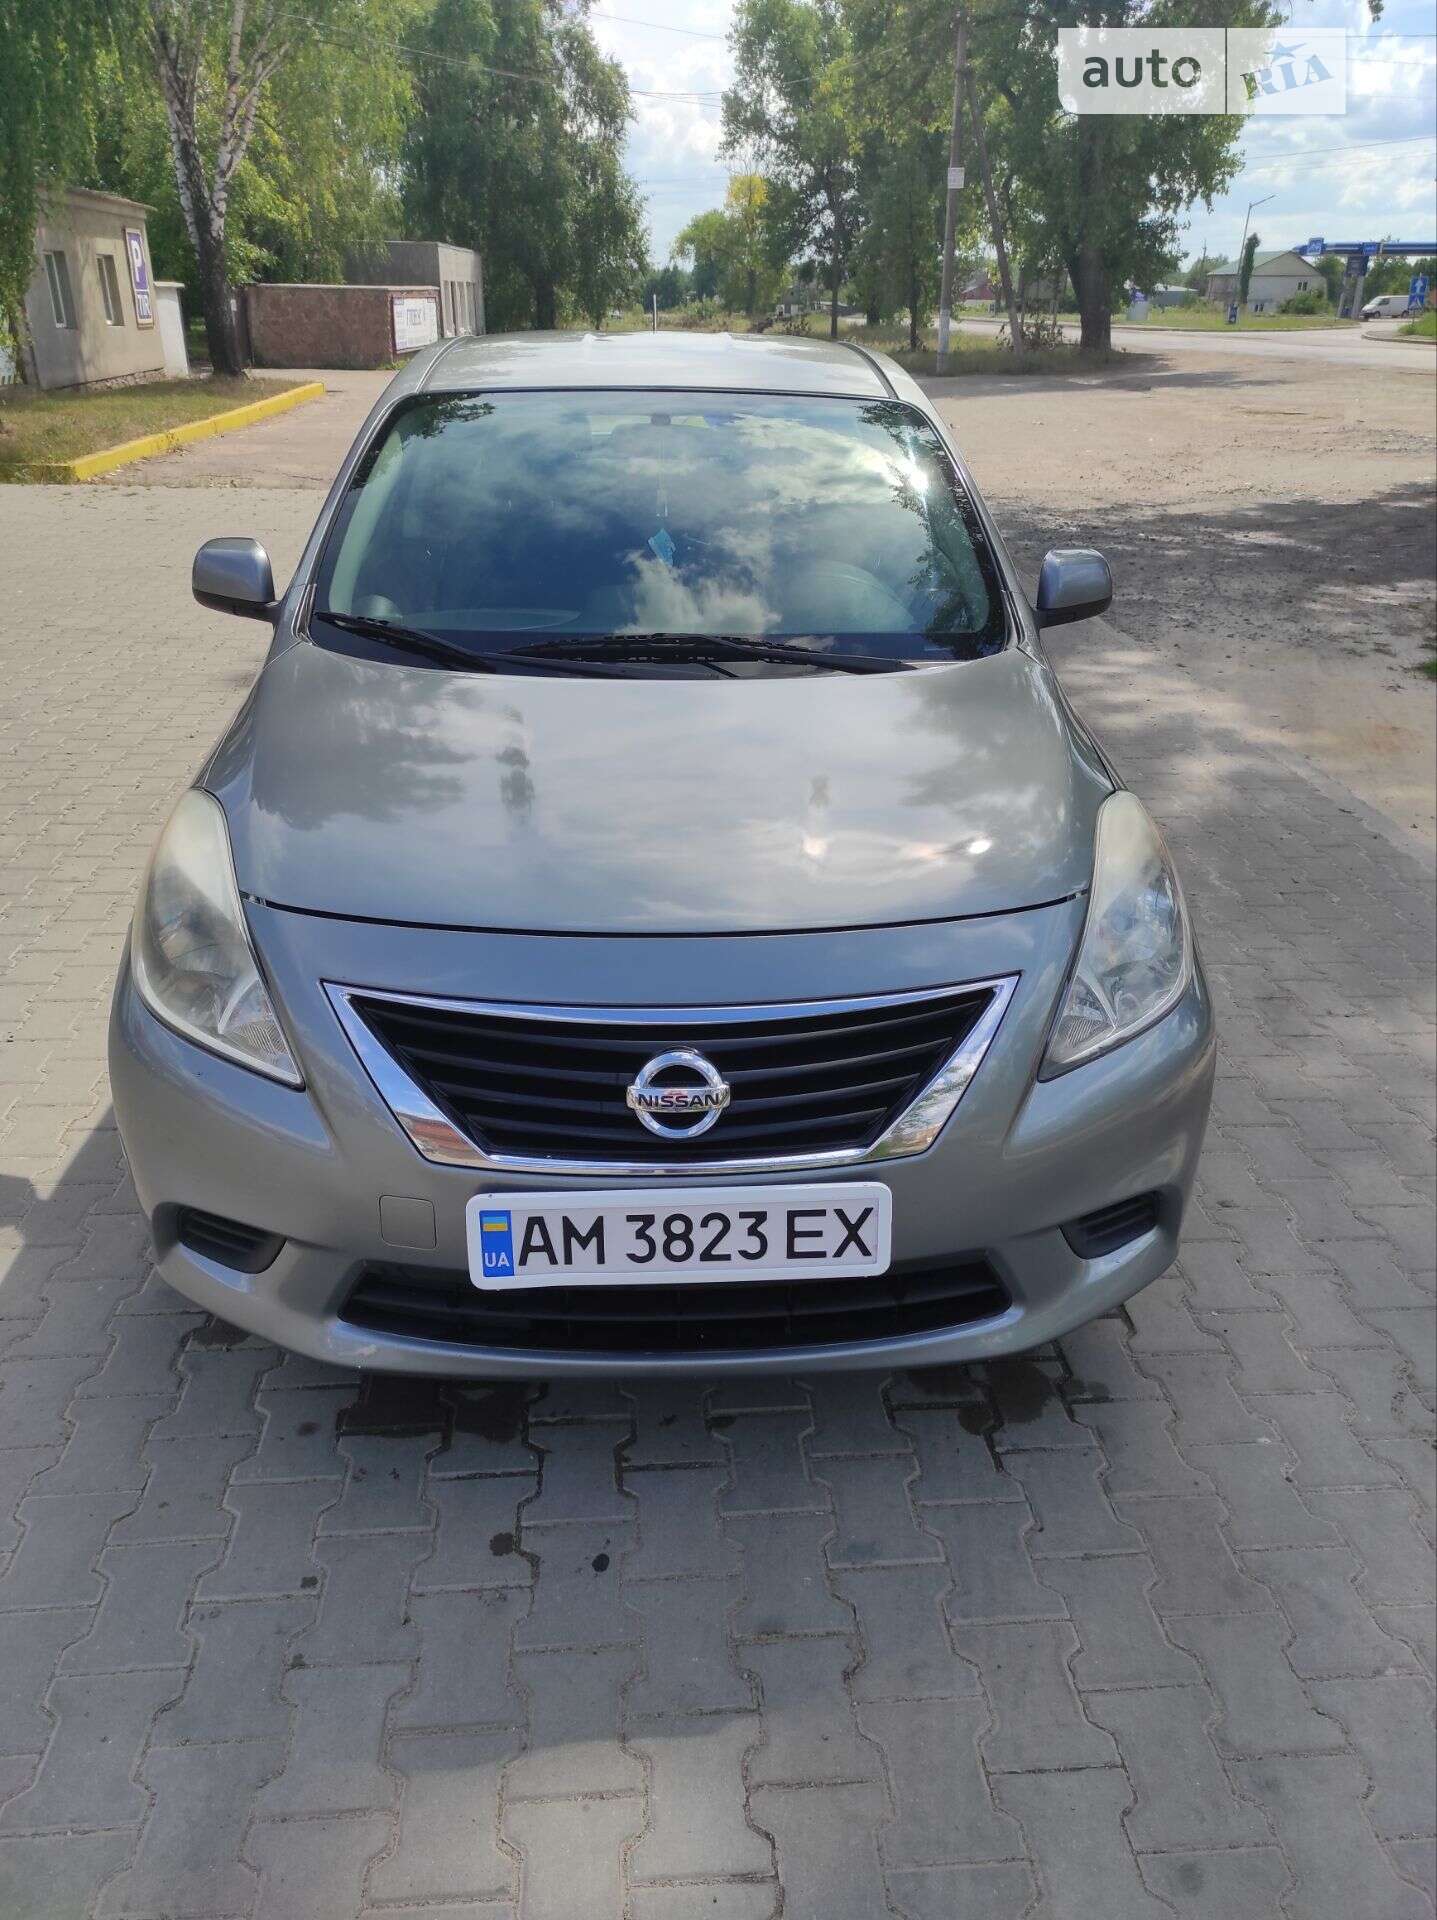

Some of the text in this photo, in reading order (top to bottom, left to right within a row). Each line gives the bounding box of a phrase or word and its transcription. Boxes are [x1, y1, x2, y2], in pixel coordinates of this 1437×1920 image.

[131, 239, 142, 283] P
[637, 1093, 719, 1108] NISSAN
[518, 1206, 874, 1267] AM 3823 EX
[484, 1252, 511, 1269] UA
